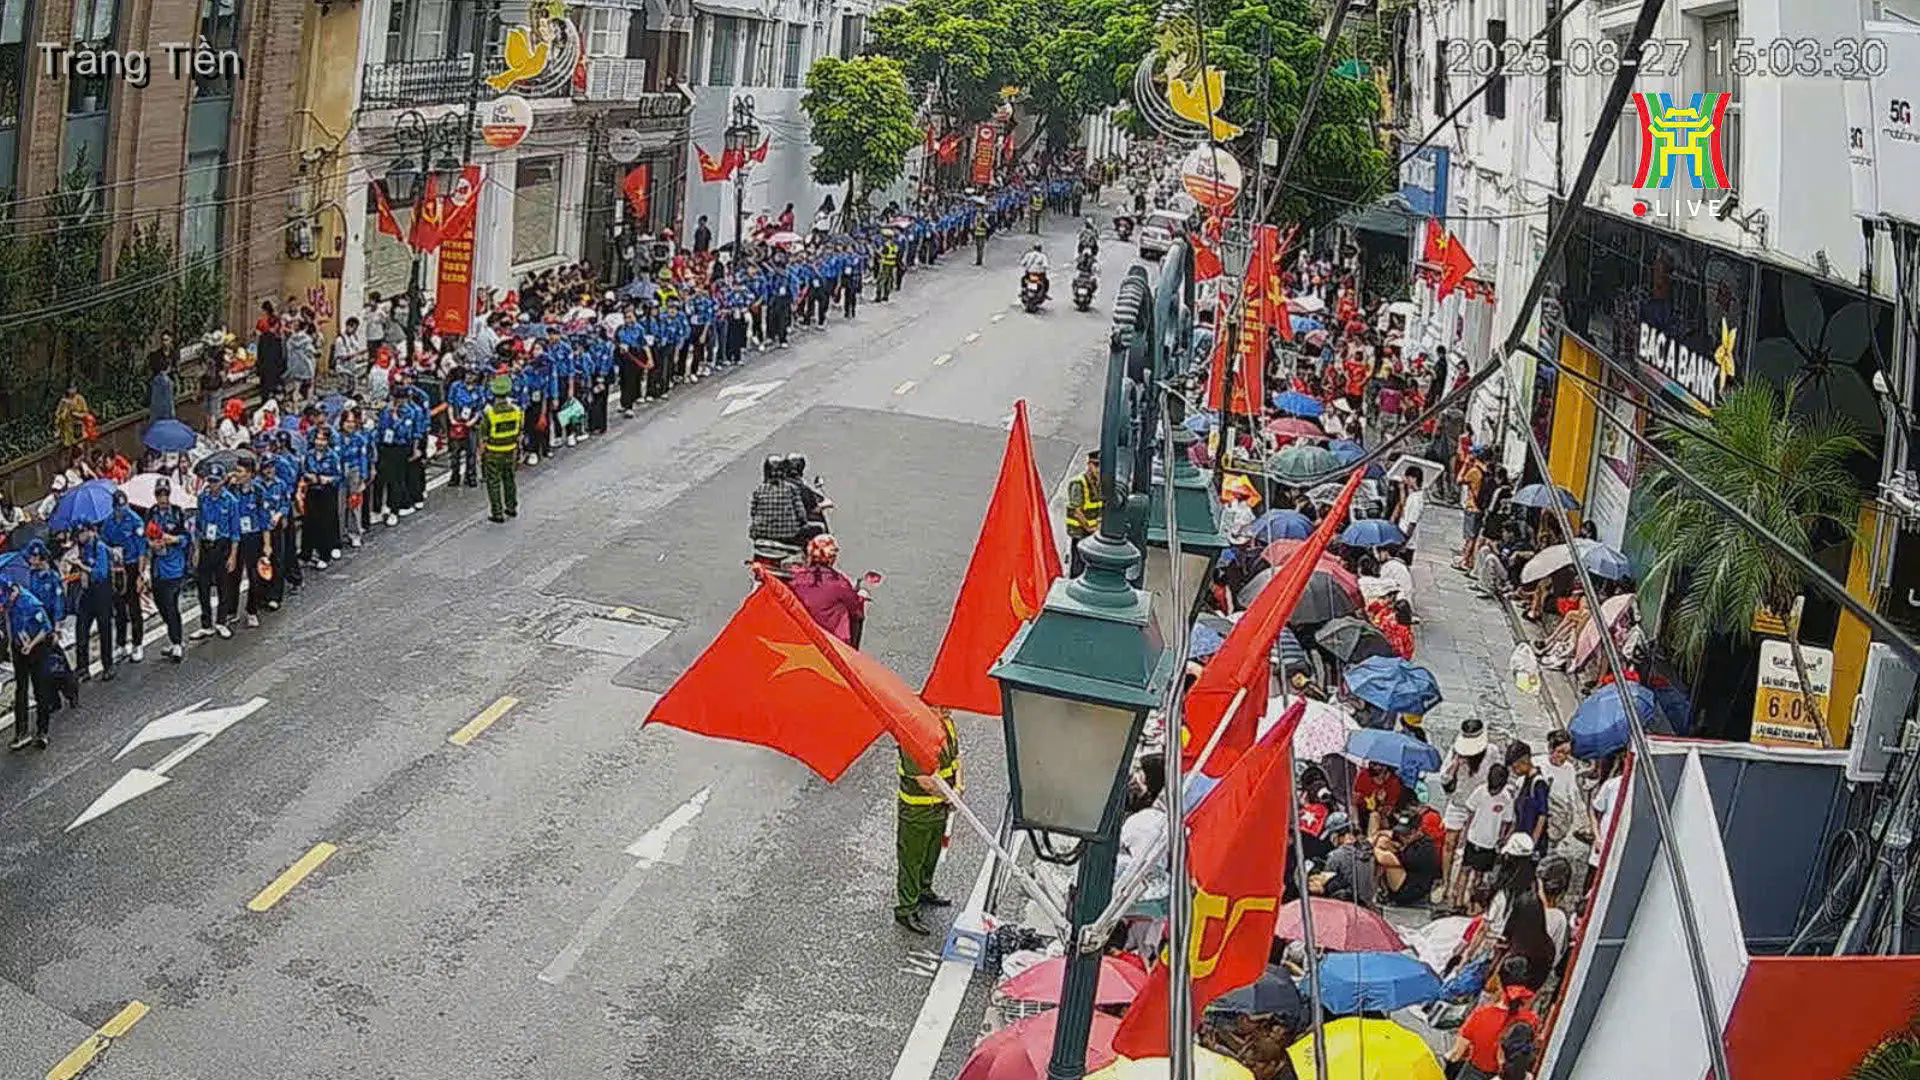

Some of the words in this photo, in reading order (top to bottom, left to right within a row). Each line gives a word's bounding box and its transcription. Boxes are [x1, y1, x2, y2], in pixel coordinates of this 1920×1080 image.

[1889, 99, 1911, 125] 5G
[1638, 321, 1668, 369] BAC
[1676, 344, 1720, 406] BANK
